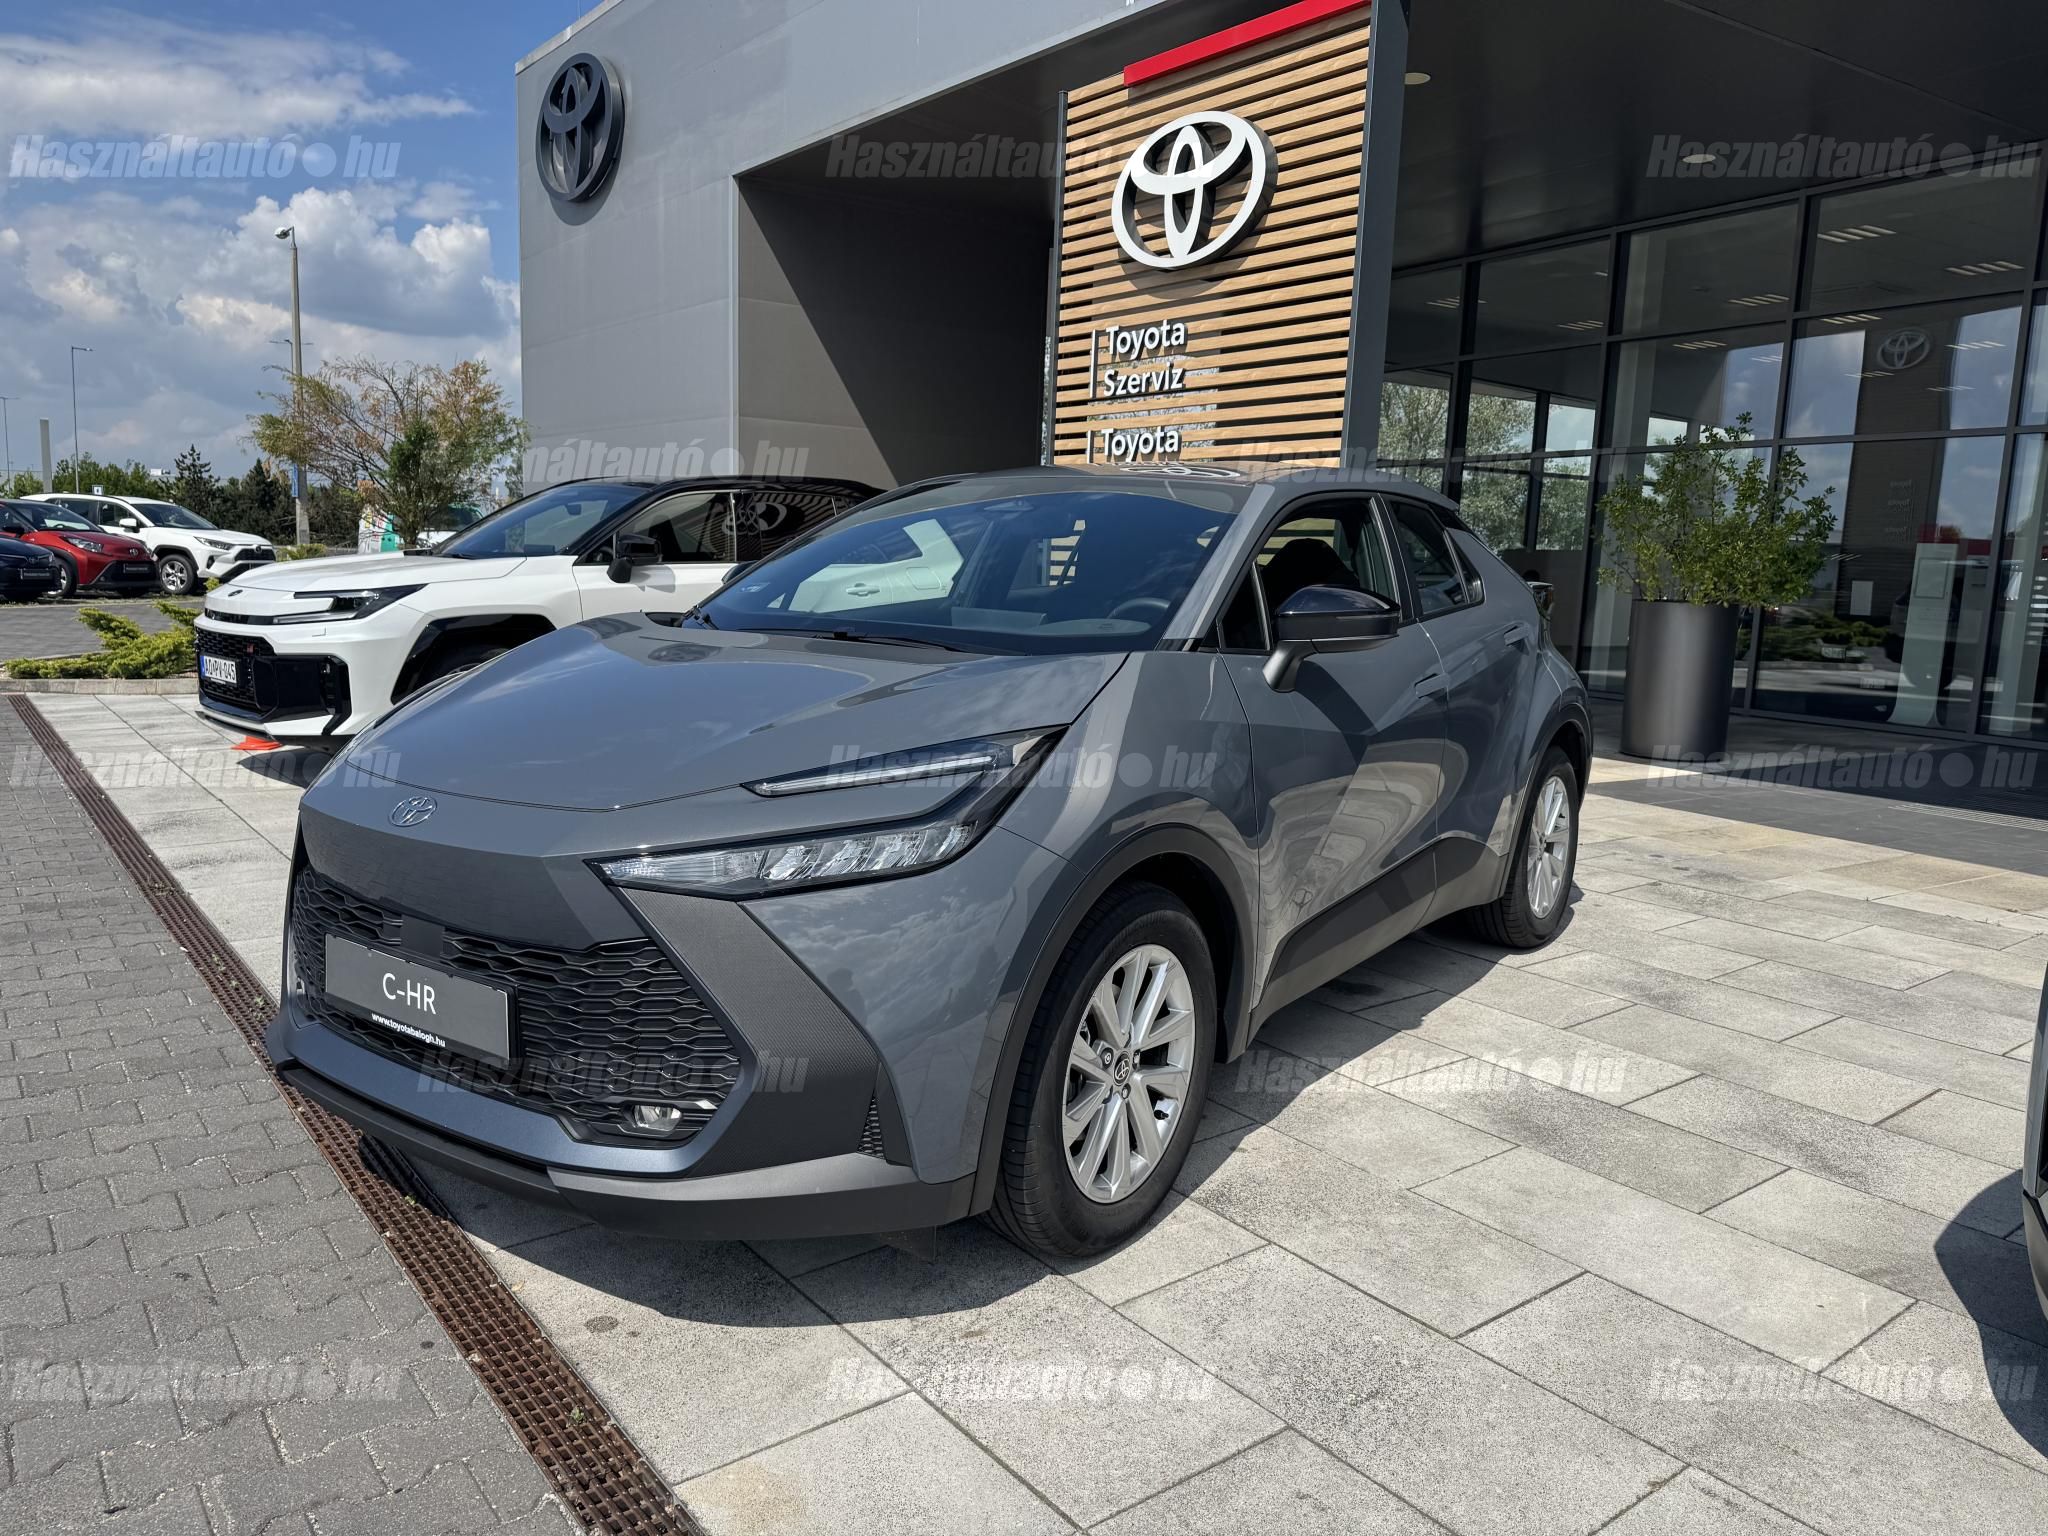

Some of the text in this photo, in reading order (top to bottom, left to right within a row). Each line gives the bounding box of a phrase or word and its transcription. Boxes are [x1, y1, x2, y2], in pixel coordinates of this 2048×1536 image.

[1106, 320, 1185, 359] Toyota
[1103, 362, 1185, 397] Szerviz
[1102, 425, 1179, 463] Toyota
[382, 972, 437, 1015] C-HR
[371, 1012, 446, 1048] www.toyotabalogh.hu
